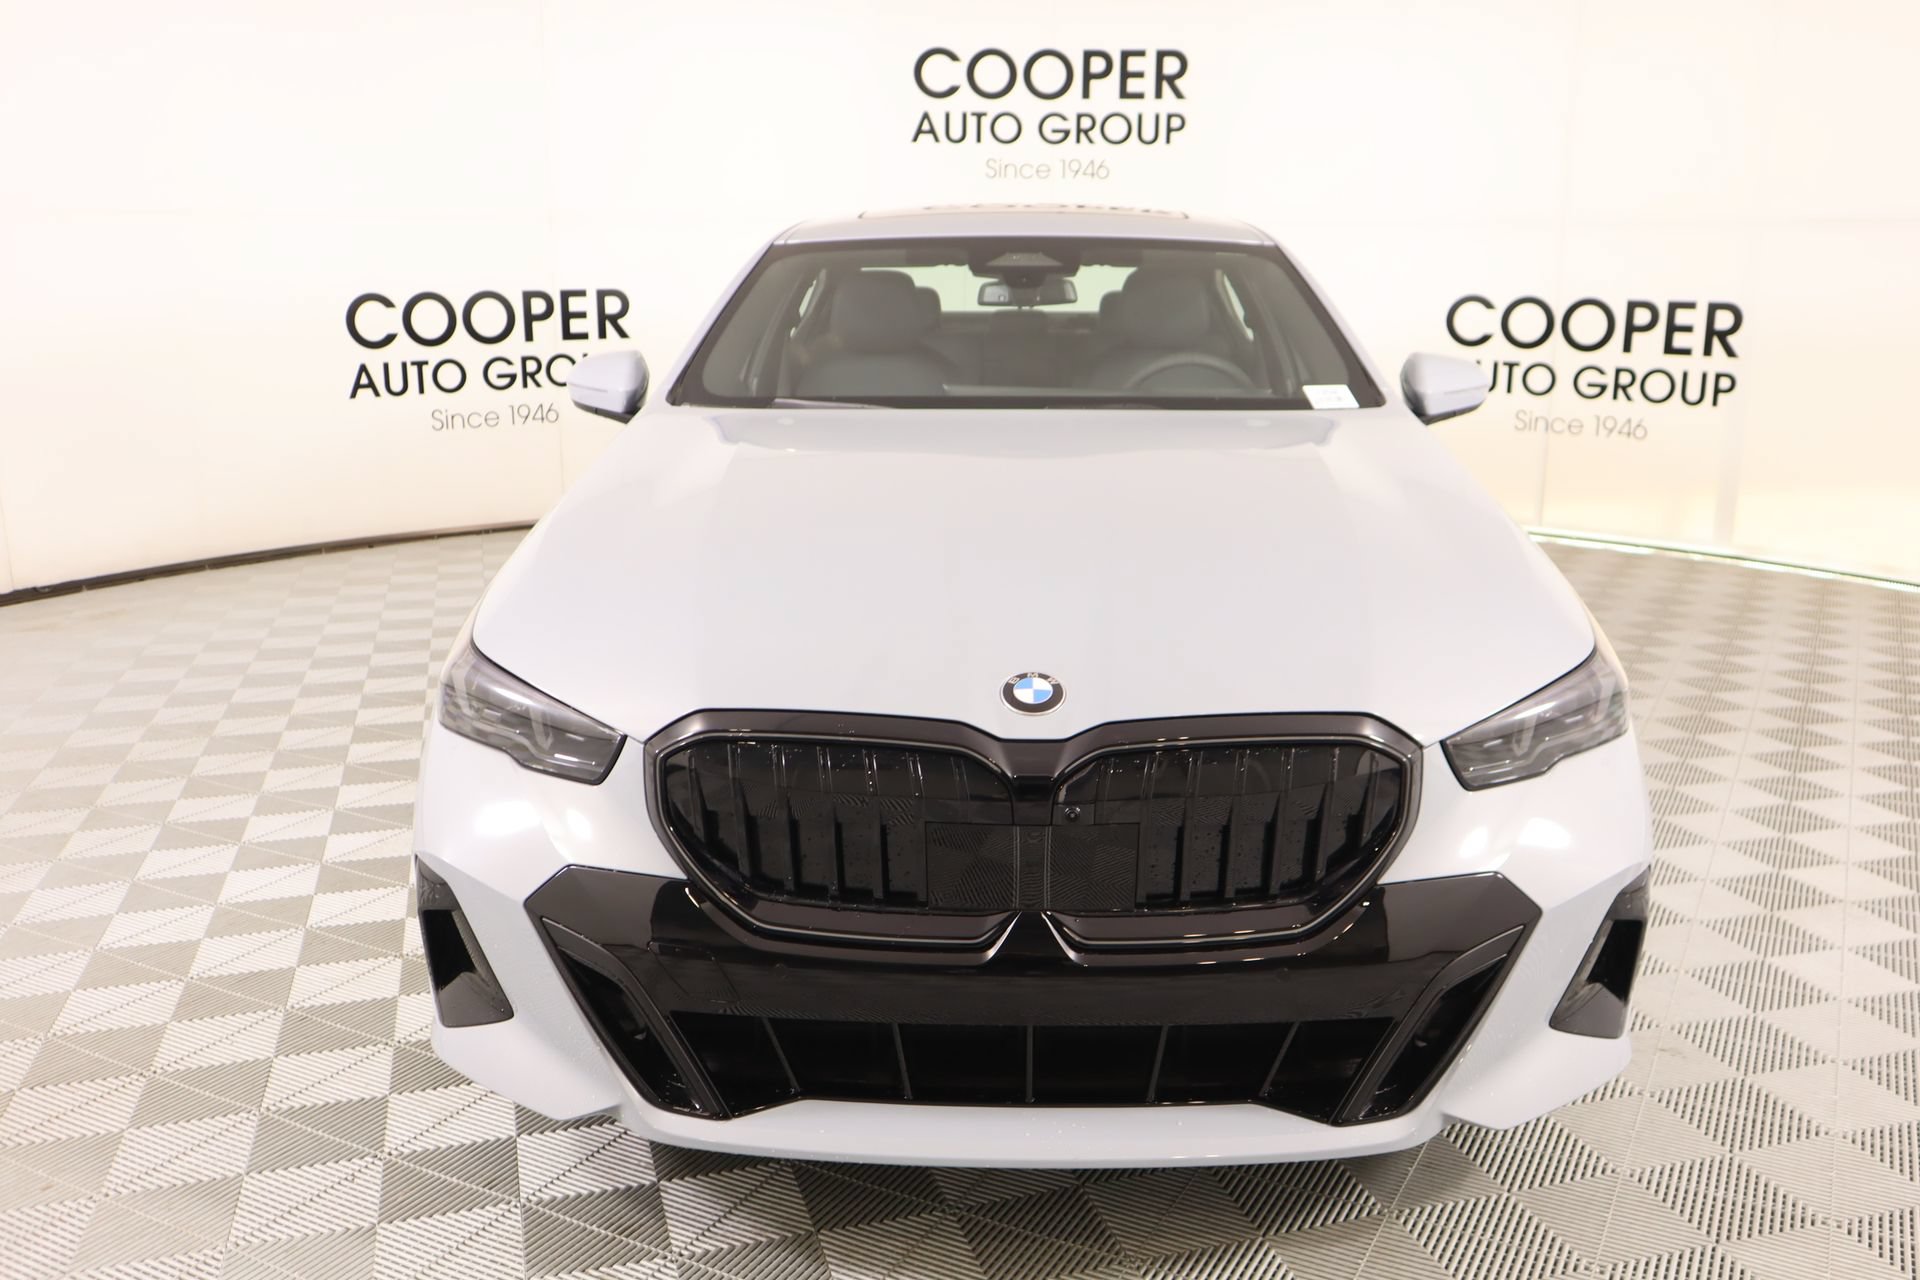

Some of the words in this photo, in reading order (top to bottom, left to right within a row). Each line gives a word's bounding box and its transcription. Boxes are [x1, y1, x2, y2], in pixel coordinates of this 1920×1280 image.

[913, 47, 1188, 101] COOPER
[911, 111, 1022, 144] AUTO
[1038, 112, 1186, 145] GROUP
[985, 158, 1051, 180] Since
[1060, 159, 1110, 180] 1946
[345, 289, 630, 350] COOPER
[1446, 294, 1744, 359] COOPER
[349, 358, 467, 399] AUTO
[482, 353, 588, 391] GRO
[1476, 358, 1557, 396] UTO
[1573, 364, 1737, 407] GROUP
[431, 409, 500, 432] Since
[508, 402, 559, 426] 1946
[1514, 409, 1584, 437] Since
[1594, 415, 1648, 442] 1946
